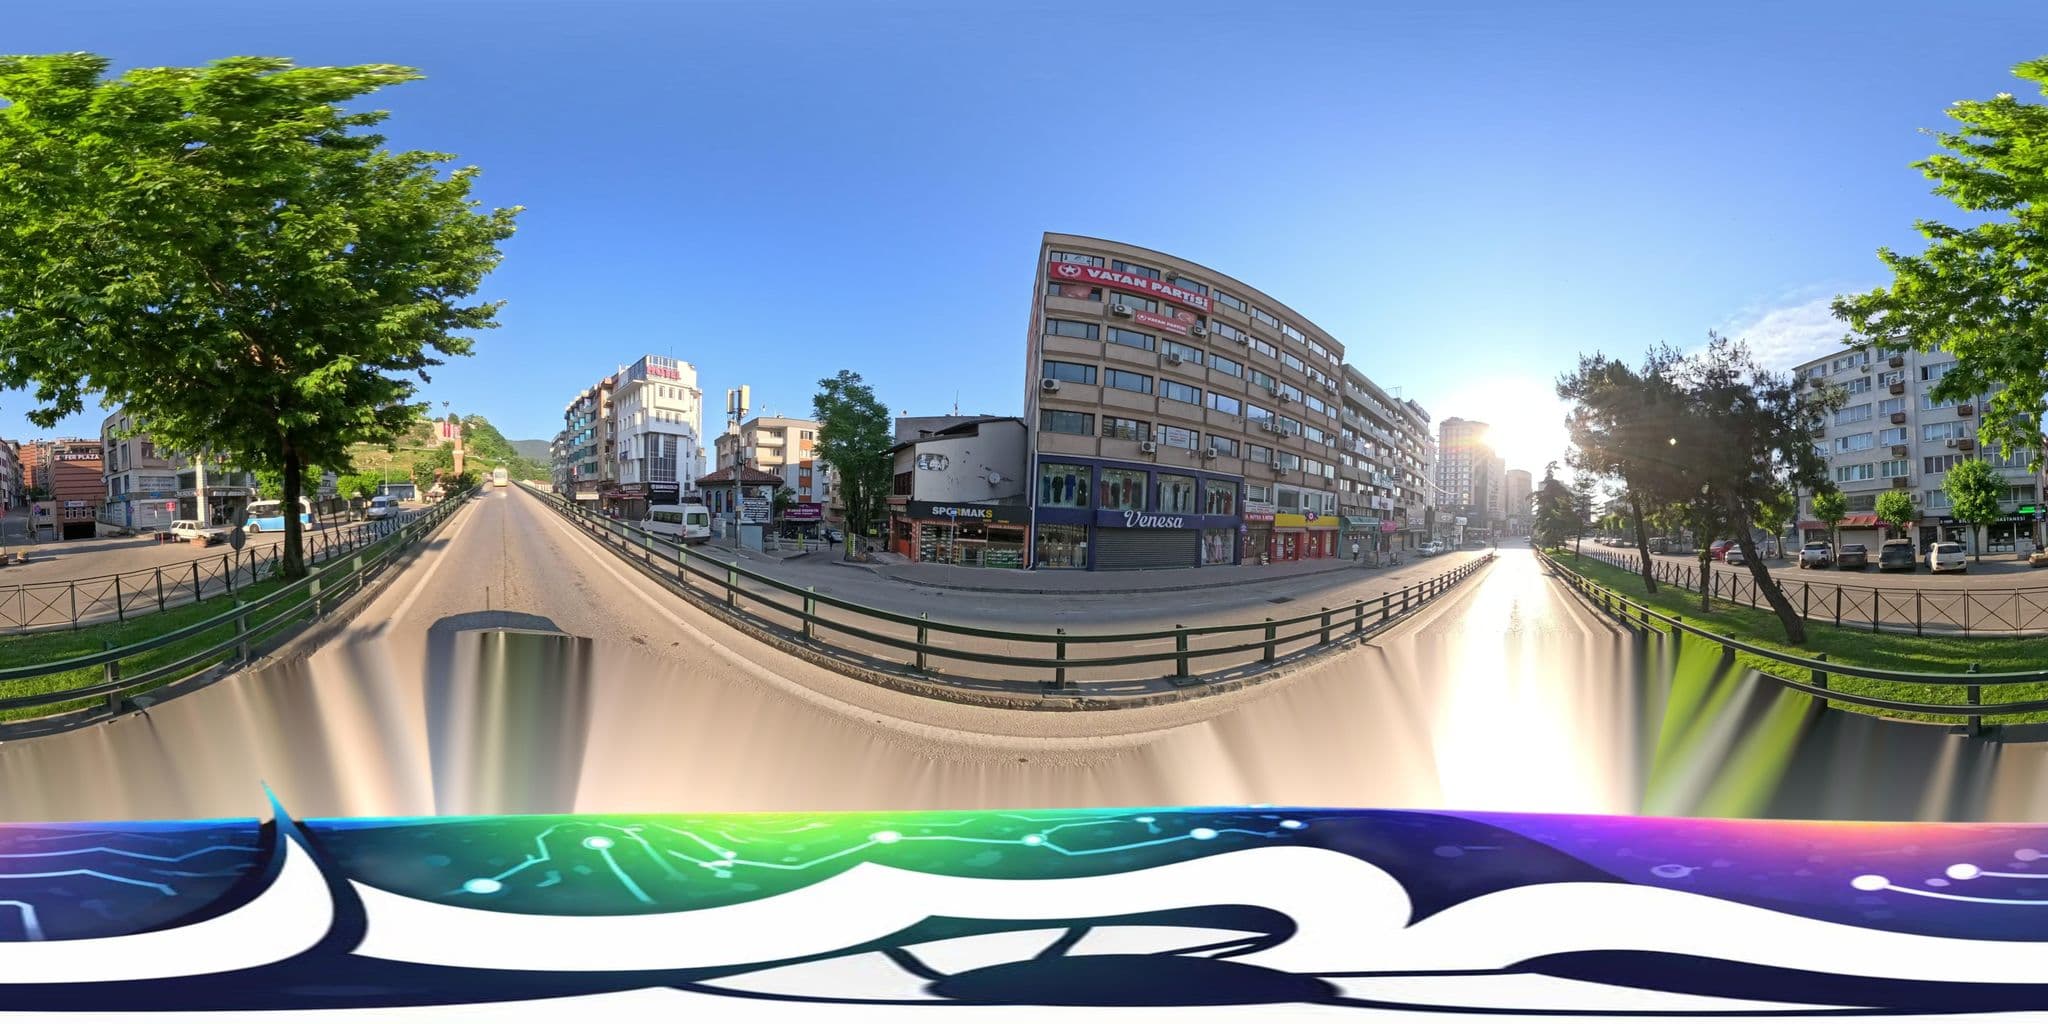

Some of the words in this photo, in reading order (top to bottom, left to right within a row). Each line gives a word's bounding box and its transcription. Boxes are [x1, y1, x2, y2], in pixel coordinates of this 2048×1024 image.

[1087, 268, 1147, 289] VATAN
[1151, 282, 1208, 308] PARTİSİ
[647, 366, 681, 379] HOTEL
[1124, 509, 1184, 528] Venesa
